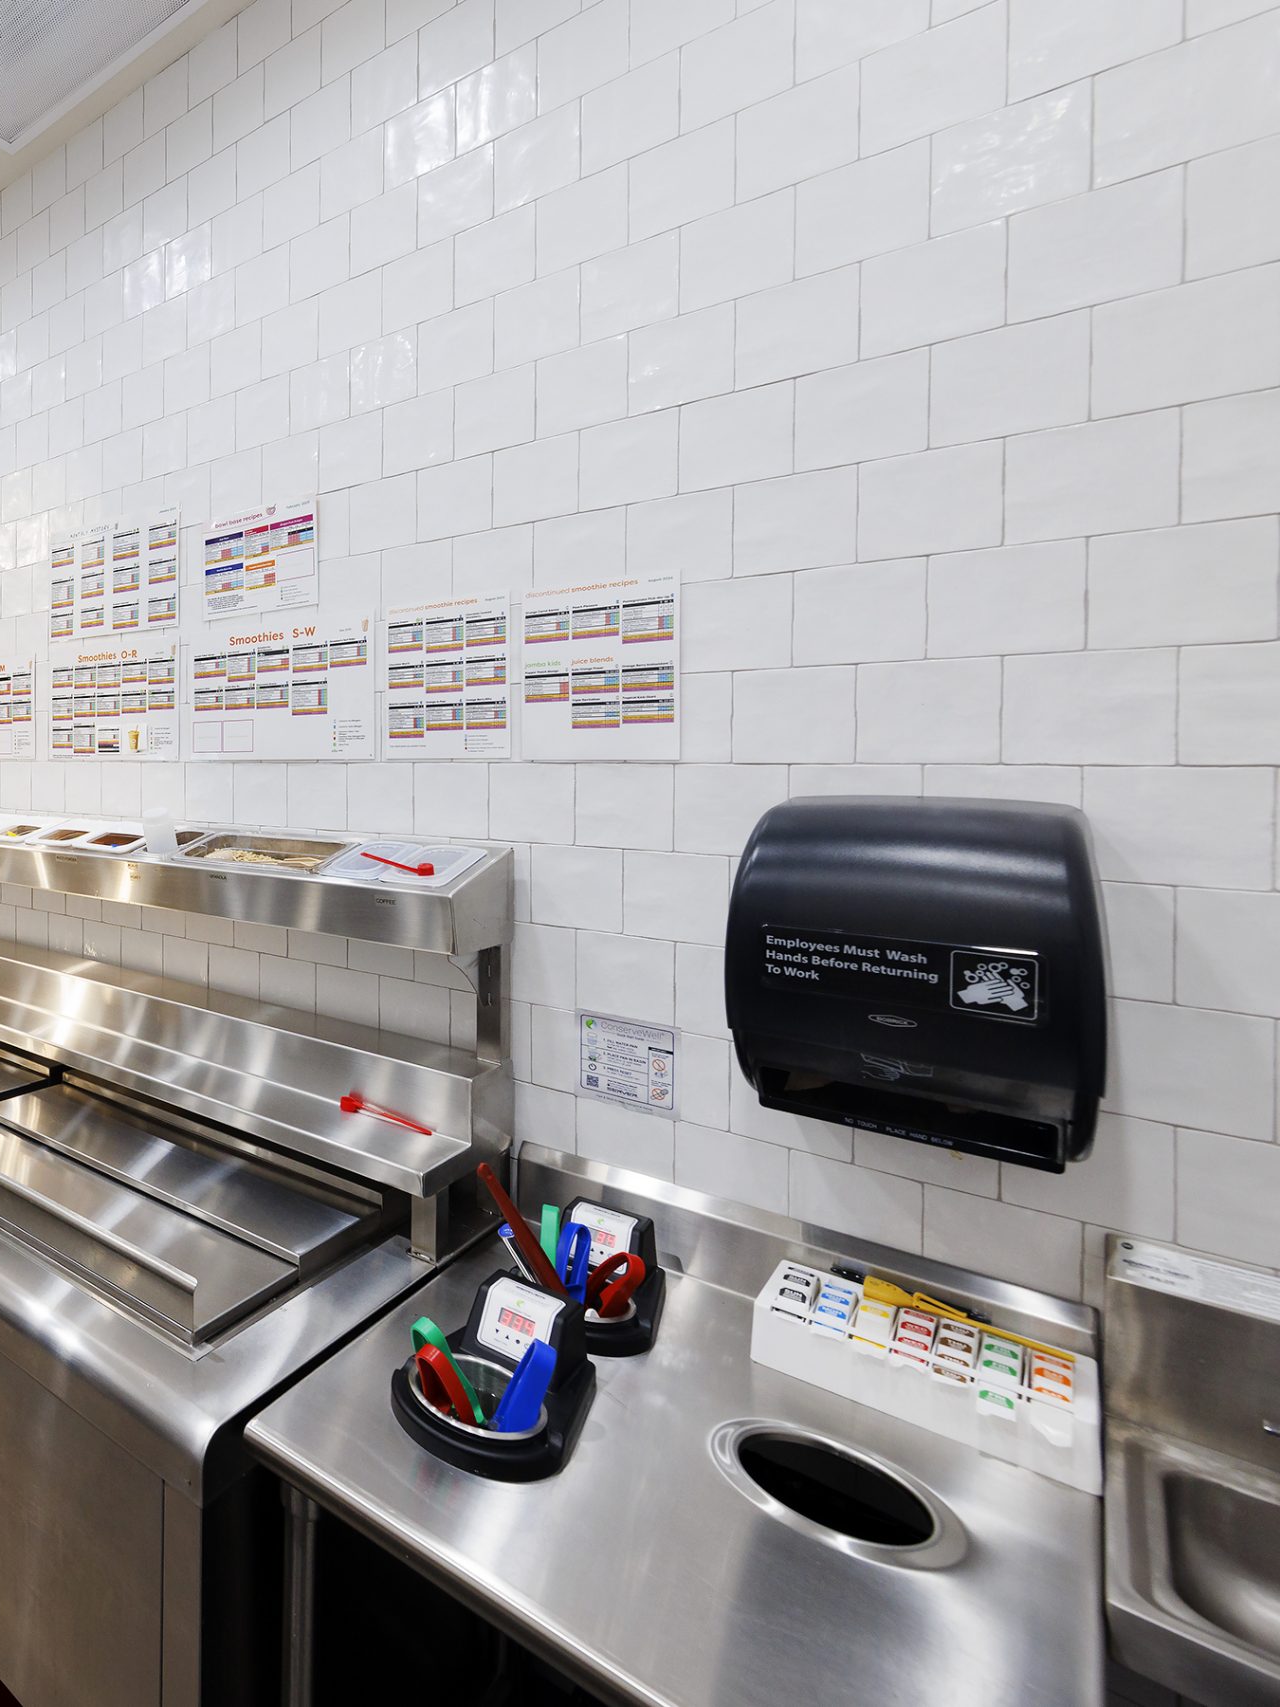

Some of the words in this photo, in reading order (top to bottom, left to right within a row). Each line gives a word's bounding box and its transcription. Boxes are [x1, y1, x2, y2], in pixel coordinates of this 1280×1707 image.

[215, 521, 229, 529] bowl
[229, 518, 242, 526] base
[242, 513, 263, 524] recipes
[525, 587, 570, 600] discontinued
[571, 583, 607, 593] smoothie
[608, 579, 639, 590] recipes
[425, 601, 453, 610] smoothie
[454, 598, 478, 607] recipes
[229, 631, 285, 646] Smoothies
[292, 626, 316, 639] S-W
[78, 651, 118, 663] Smoothies
[121, 649, 138, 660] O-R
[524, 661, 547, 669] jamba
[547, 660, 562, 668] kids
[571, 657, 588, 667] juice
[589, 656, 614, 665] blends
[375, 897, 396, 906] COFFEE
[766, 934, 840, 954] Employees
[843, 944, 881, 959] Must
[885, 949, 928, 964] Wash
[765, 963, 782, 975] To
[783, 966, 820, 981] Work
[766, 949, 809, 964] Hands
[811, 955, 859, 971] Before
[861, 962, 939, 984] Returning
[856, 1119, 878, 1129] TOUCH
[885, 1126, 906, 1136] PLACE
[909, 1132, 928, 1140] HAND
